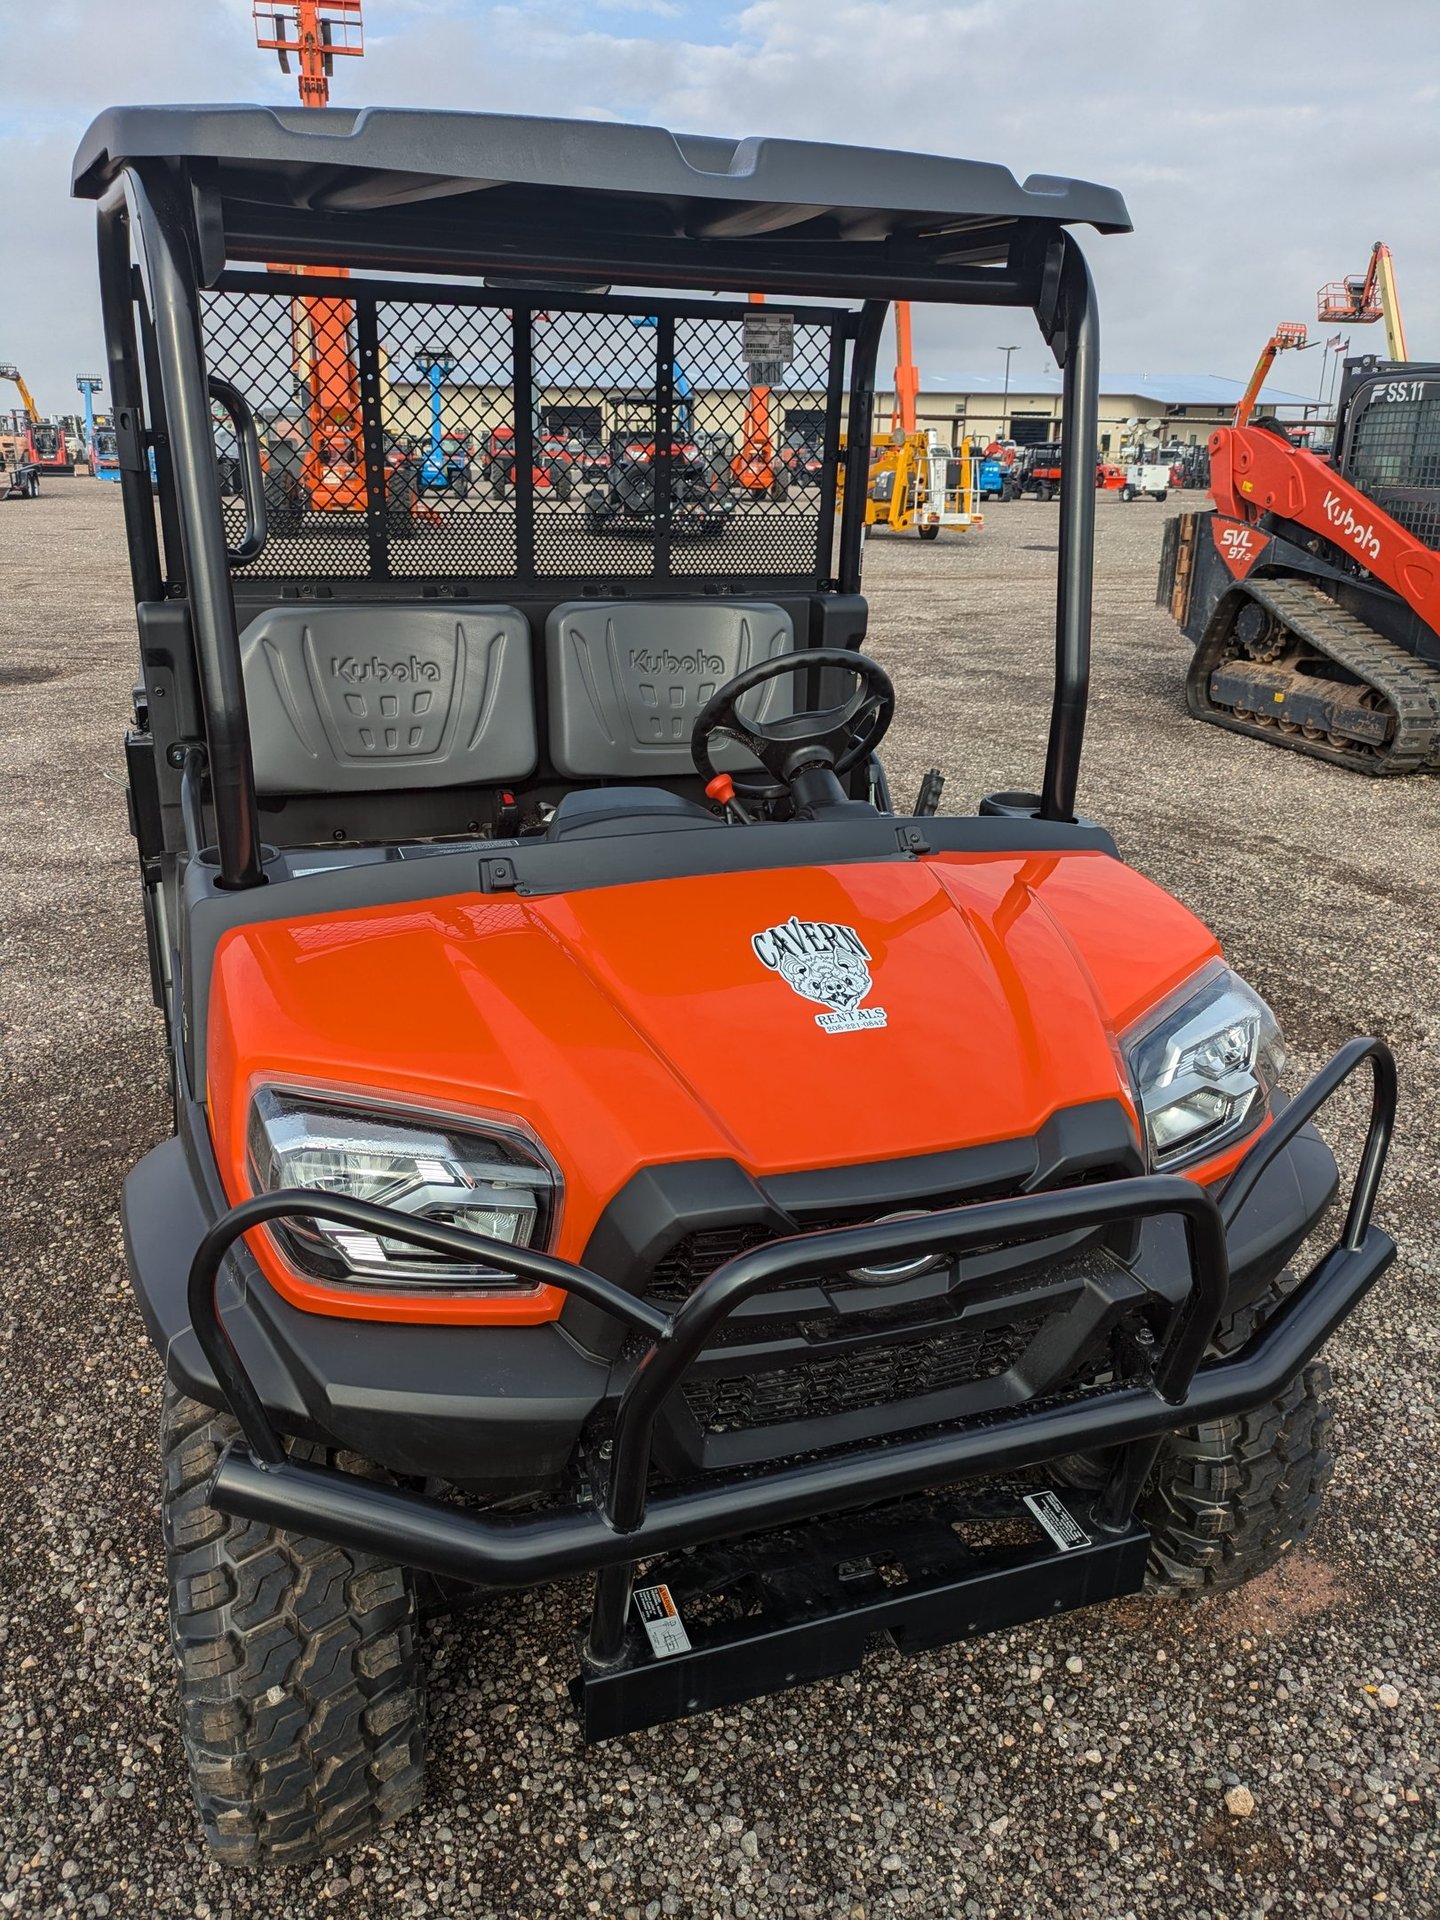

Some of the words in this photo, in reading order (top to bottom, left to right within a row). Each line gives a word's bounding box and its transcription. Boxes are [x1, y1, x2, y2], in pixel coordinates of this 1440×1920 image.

[1323, 490, 1381, 559] Kubota
[1220, 529, 1253, 547] SVL
[331, 655, 440, 683] Kubota
[629, 649, 726, 675] Kubota
[753, 917, 871, 968] CAVERN
[817, 1009, 885, 1025] RENTALS
[826, 1020, 885, 1032] 208-221-0842
